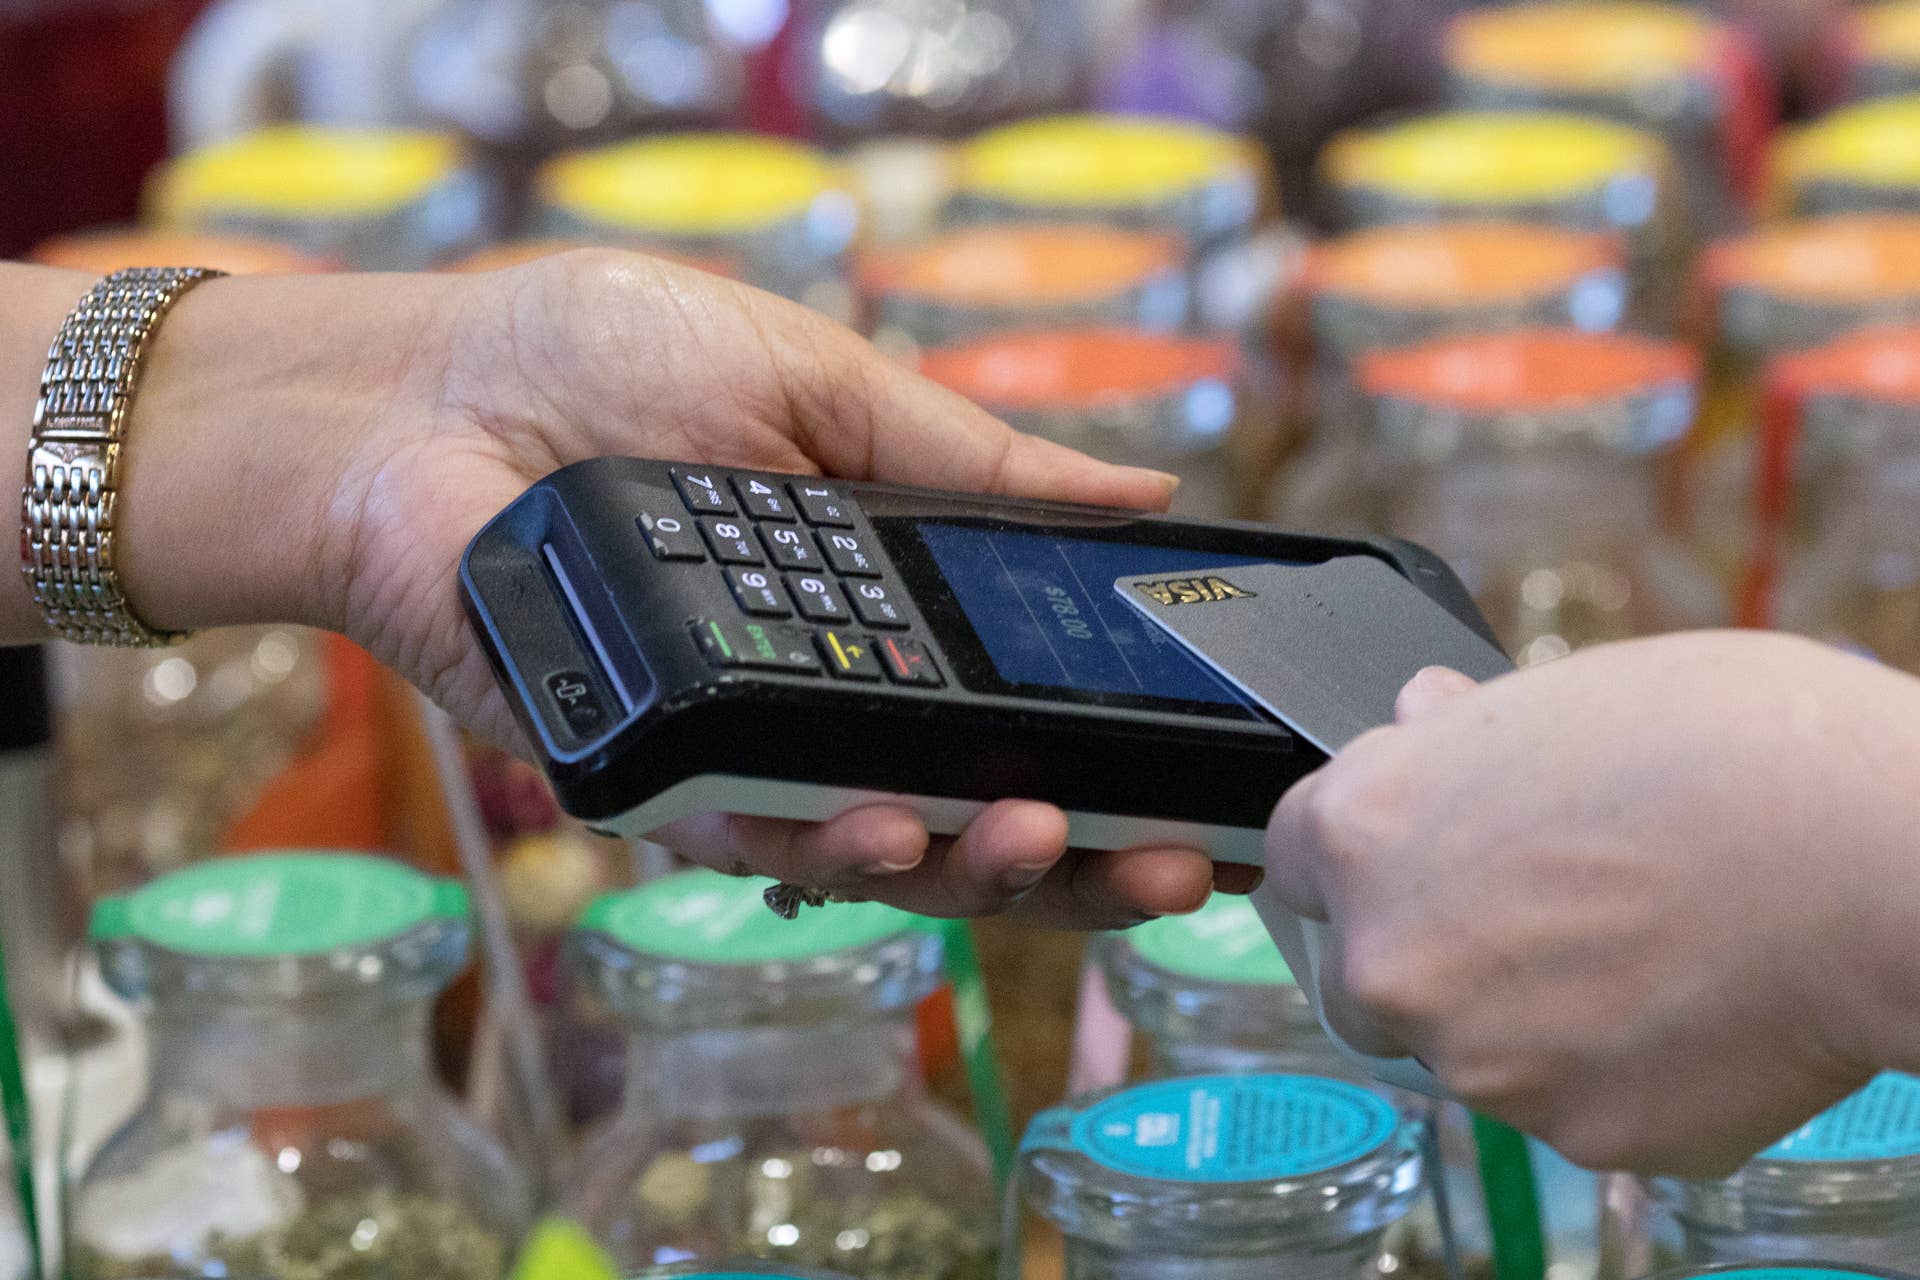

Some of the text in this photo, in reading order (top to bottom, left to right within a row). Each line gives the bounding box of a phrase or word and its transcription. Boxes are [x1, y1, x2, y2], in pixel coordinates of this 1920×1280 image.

[686, 475, 713, 489] 7
[750, 480, 772, 495] 4
[805, 487, 829, 497] 1
[657, 518, 680, 532] 0
[716, 523, 740, 538] 8
[774, 529, 799, 544] 5
[832, 535, 857, 551] 2
[742, 573, 767, 588] 9
[801, 578, 825, 593] 6
[860, 584, 885, 600] 3
[1133, 576, 1257, 605] VISA
